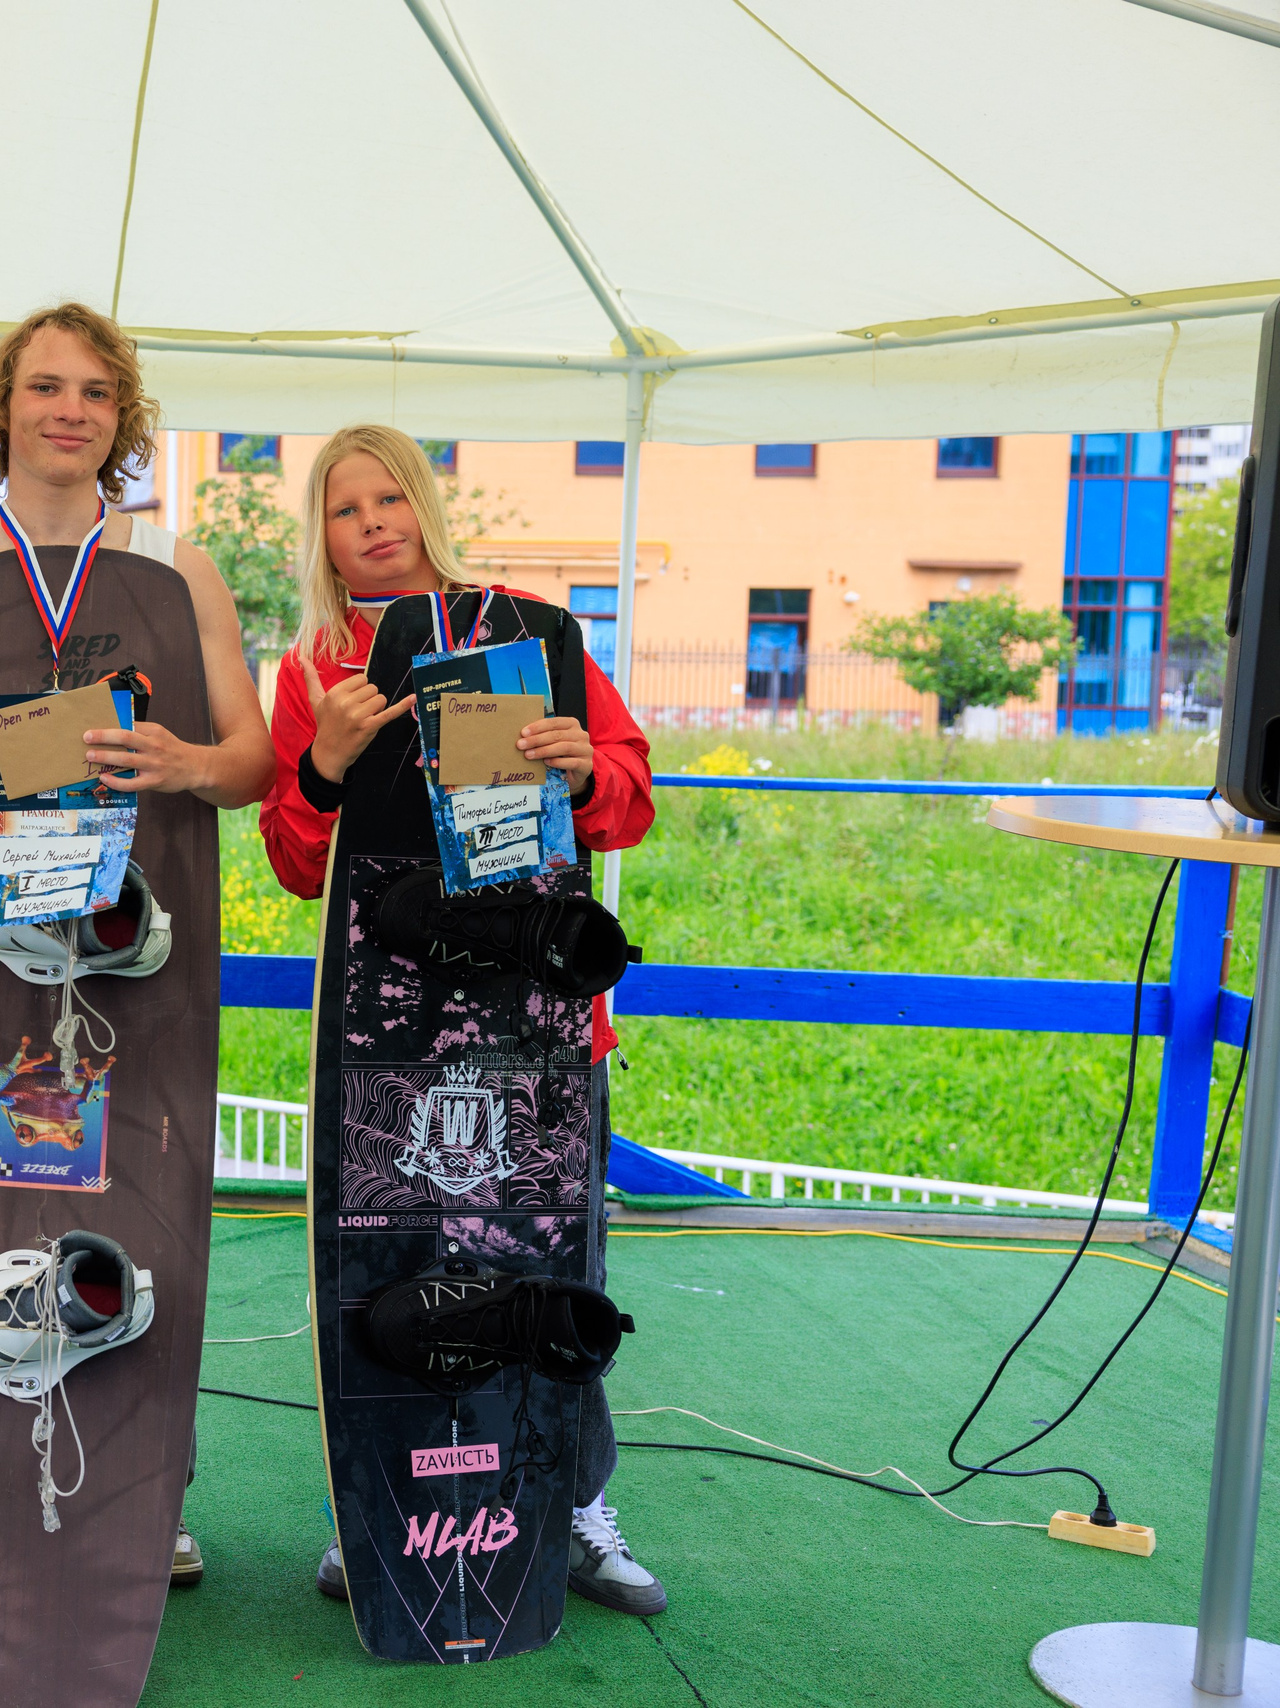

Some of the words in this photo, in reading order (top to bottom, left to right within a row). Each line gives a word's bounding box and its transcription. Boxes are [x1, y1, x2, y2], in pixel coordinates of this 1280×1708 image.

[37, 633, 121, 659] SRED
[64, 658, 91, 670] AND
[29, 706, 51, 720] men
[449, 697, 473, 717] Open
[475, 702, 497, 713] men
[2, 848, 39, 867] Сергей
[43, 847, 91, 862] Михайлов
[552, 1045, 580, 1063] 140
[19, 1162, 74, 1177] BREEZE
[403, 1507, 519, 1560] MLAB
